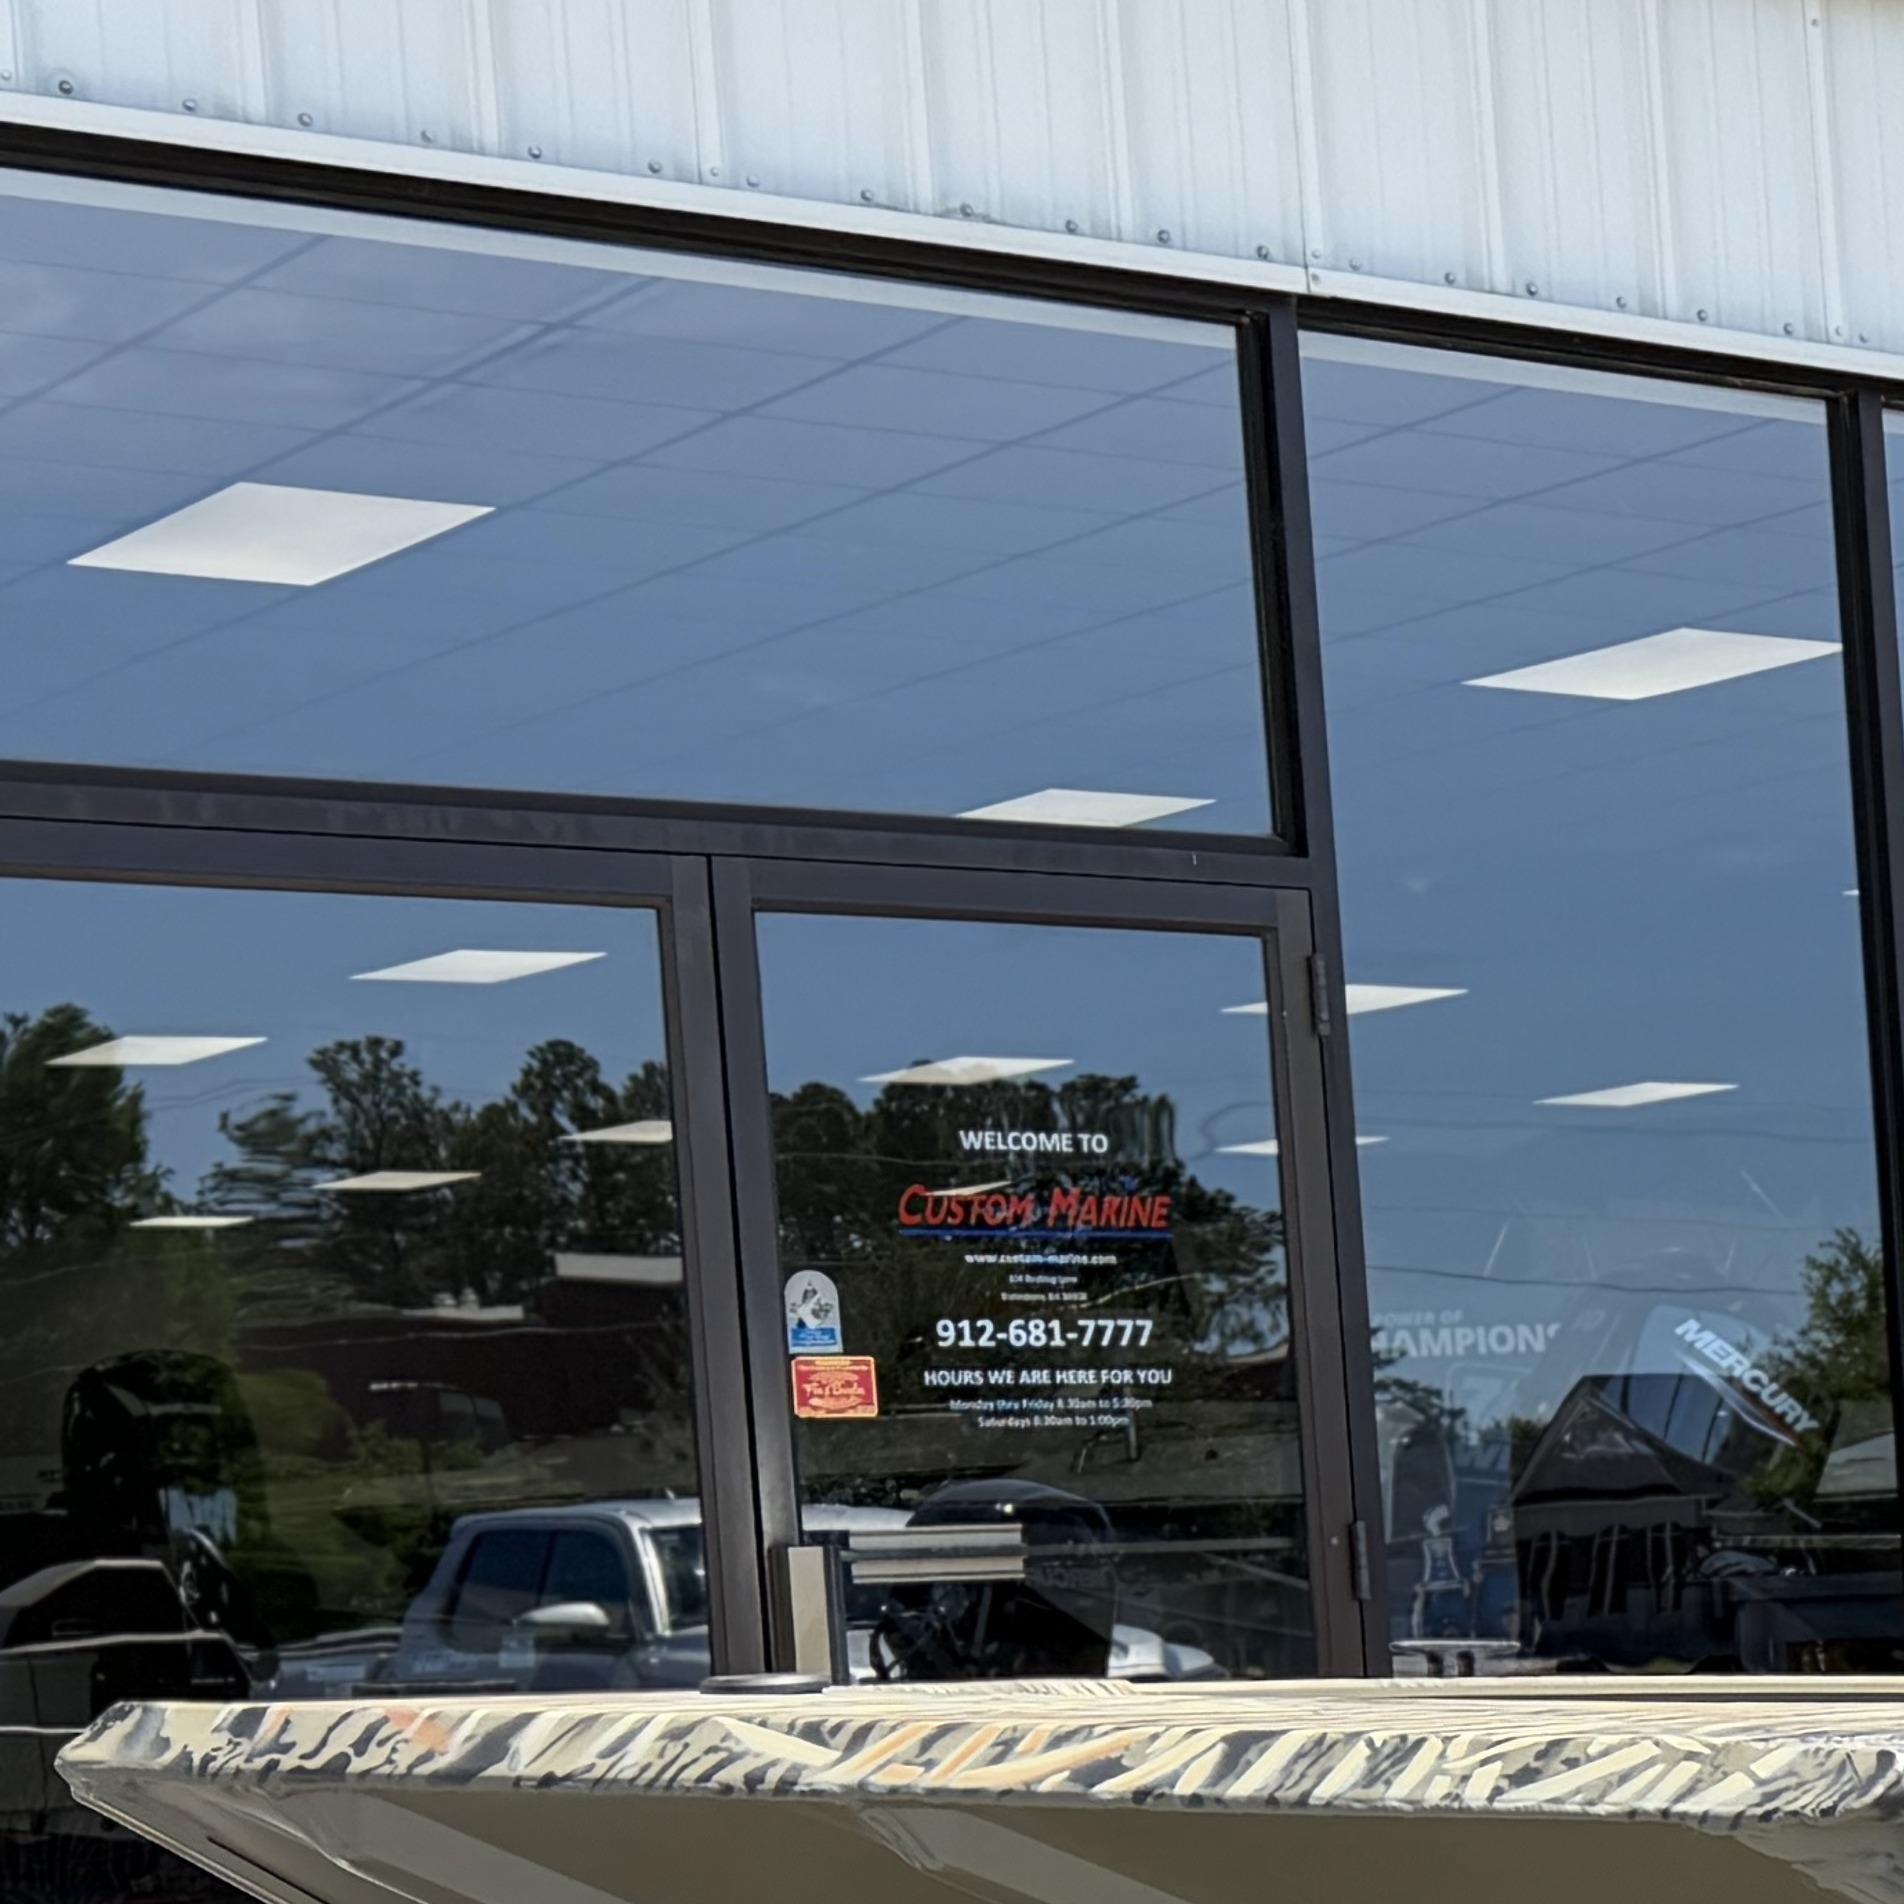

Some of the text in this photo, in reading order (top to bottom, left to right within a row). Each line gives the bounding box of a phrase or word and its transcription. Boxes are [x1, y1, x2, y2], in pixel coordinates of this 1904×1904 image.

[959, 1131, 1108, 1153] WELCOME TO
[898, 1184, 1172, 1228] CUSTOM MARINE
[936, 1318, 1153, 1347] 912-681-7777
[924, 1368, 1172, 1386] HOURS WE ARE HERE FOR YOU
[1674, 1318, 1820, 1434] MERCURY
